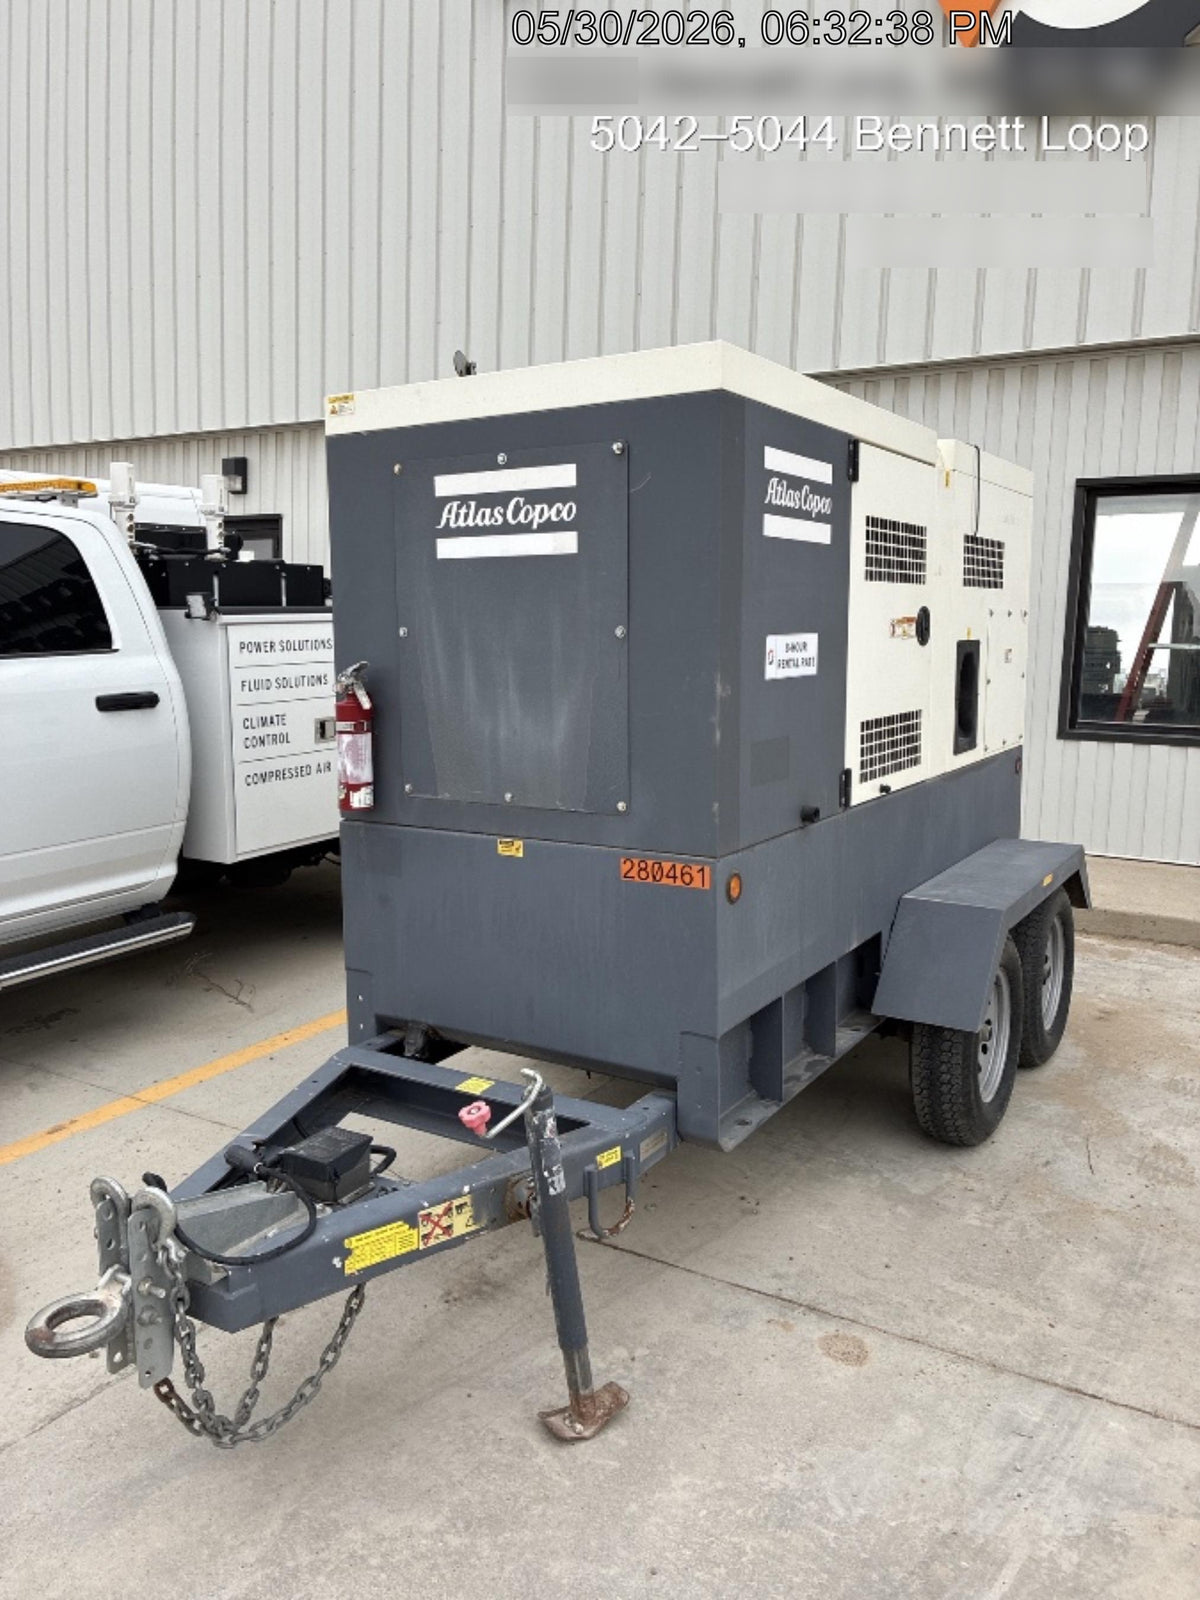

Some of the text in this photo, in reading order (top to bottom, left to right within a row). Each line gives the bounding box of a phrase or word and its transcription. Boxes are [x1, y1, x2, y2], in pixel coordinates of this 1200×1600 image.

[764, 476, 833, 518] Atlas Copco
[436, 496, 577, 530] Atlas Copco
[239, 638, 333, 654] POWER SOLUTIONS
[241, 674, 329, 692] FLUID SOLUTIONS
[243, 714, 287, 730] CLIMATE
[244, 732, 291, 749] CONTROL
[245, 762, 332, 786] COMPRESSED AIR
[622, 858, 707, 888] 280461
